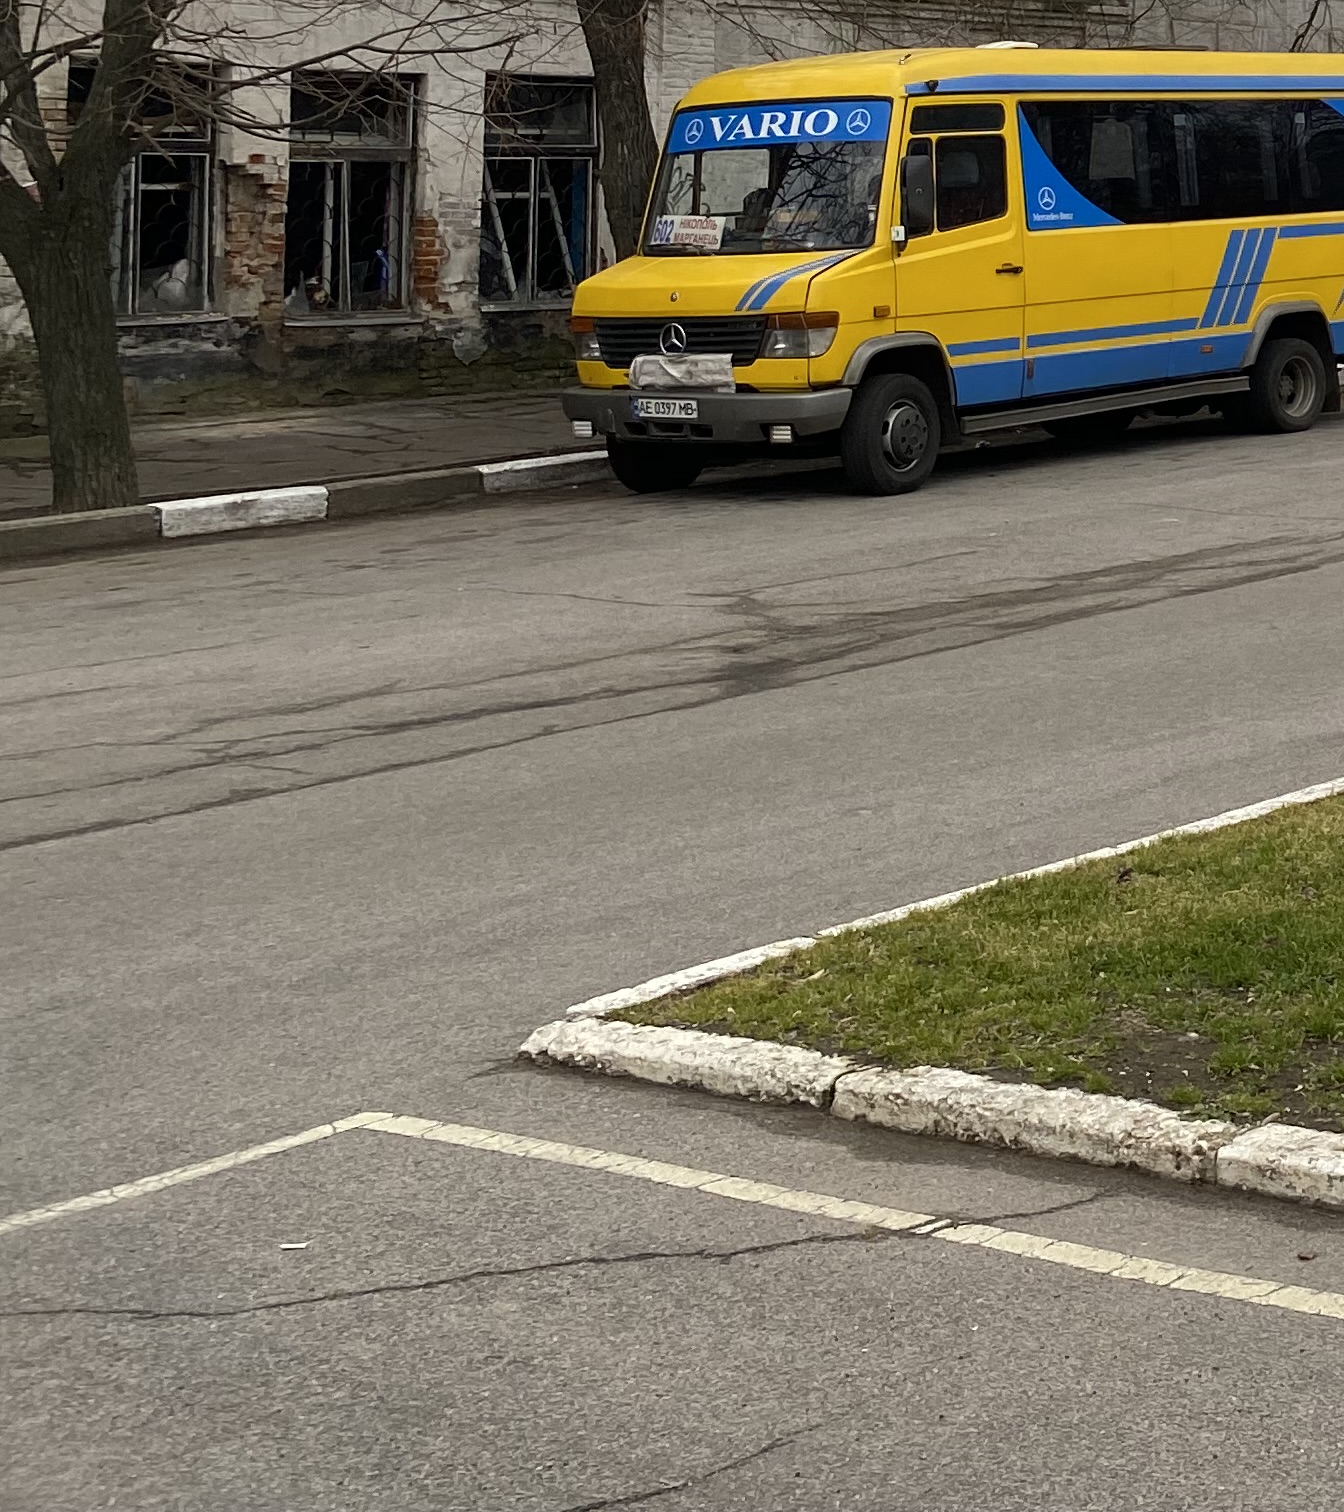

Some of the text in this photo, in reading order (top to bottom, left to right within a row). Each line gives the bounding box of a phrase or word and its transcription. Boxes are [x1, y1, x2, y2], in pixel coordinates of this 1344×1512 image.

[710, 108, 839, 141] VARIO
[653, 219, 675, 243] 602
[673, 232, 719, 245] МАРГАНЕЦЬ
[640, 401, 653, 414] AE
[654, 402, 677, 415] 0397
